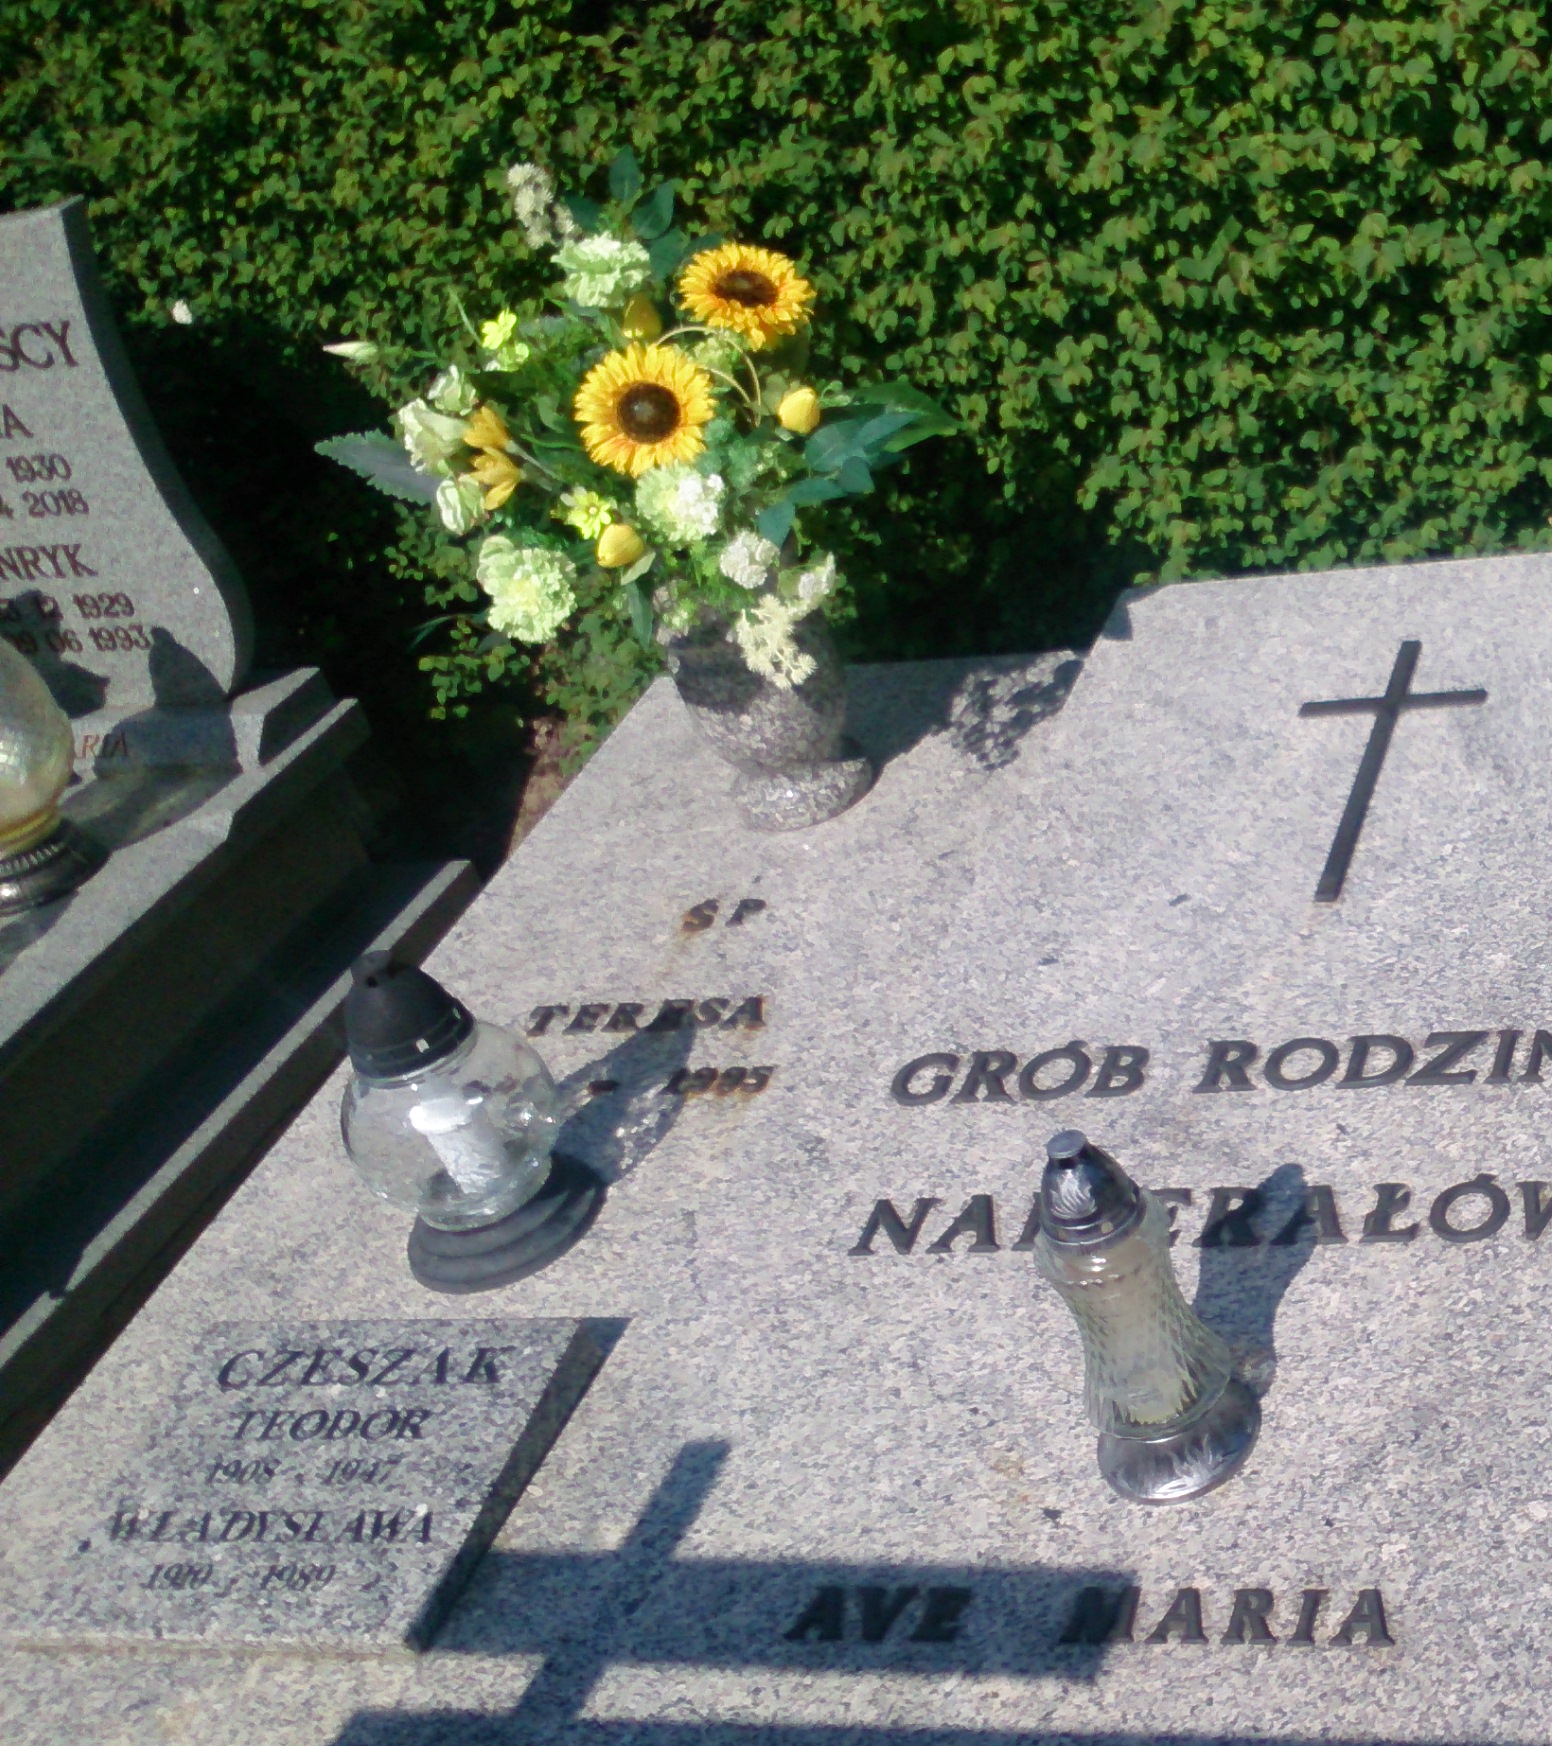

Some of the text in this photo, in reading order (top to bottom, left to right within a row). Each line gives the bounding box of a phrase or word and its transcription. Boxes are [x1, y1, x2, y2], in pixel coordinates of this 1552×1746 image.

[6, 453, 72, 483] 1930
[22, 488, 90, 519] 2018
[0, 543, 99, 582] NRYK
[72, 592, 135, 620] 1929
[89, 624, 151, 652] 1993
[526, 994, 769, 1037] TERESA
[890, 1038, 1150, 1108] GRÓB
[215, 1345, 518, 1392] CZESZAK
[228, 1406, 434, 1442] TEODOR
[783, 1584, 1397, 1648] AVE MARIA
